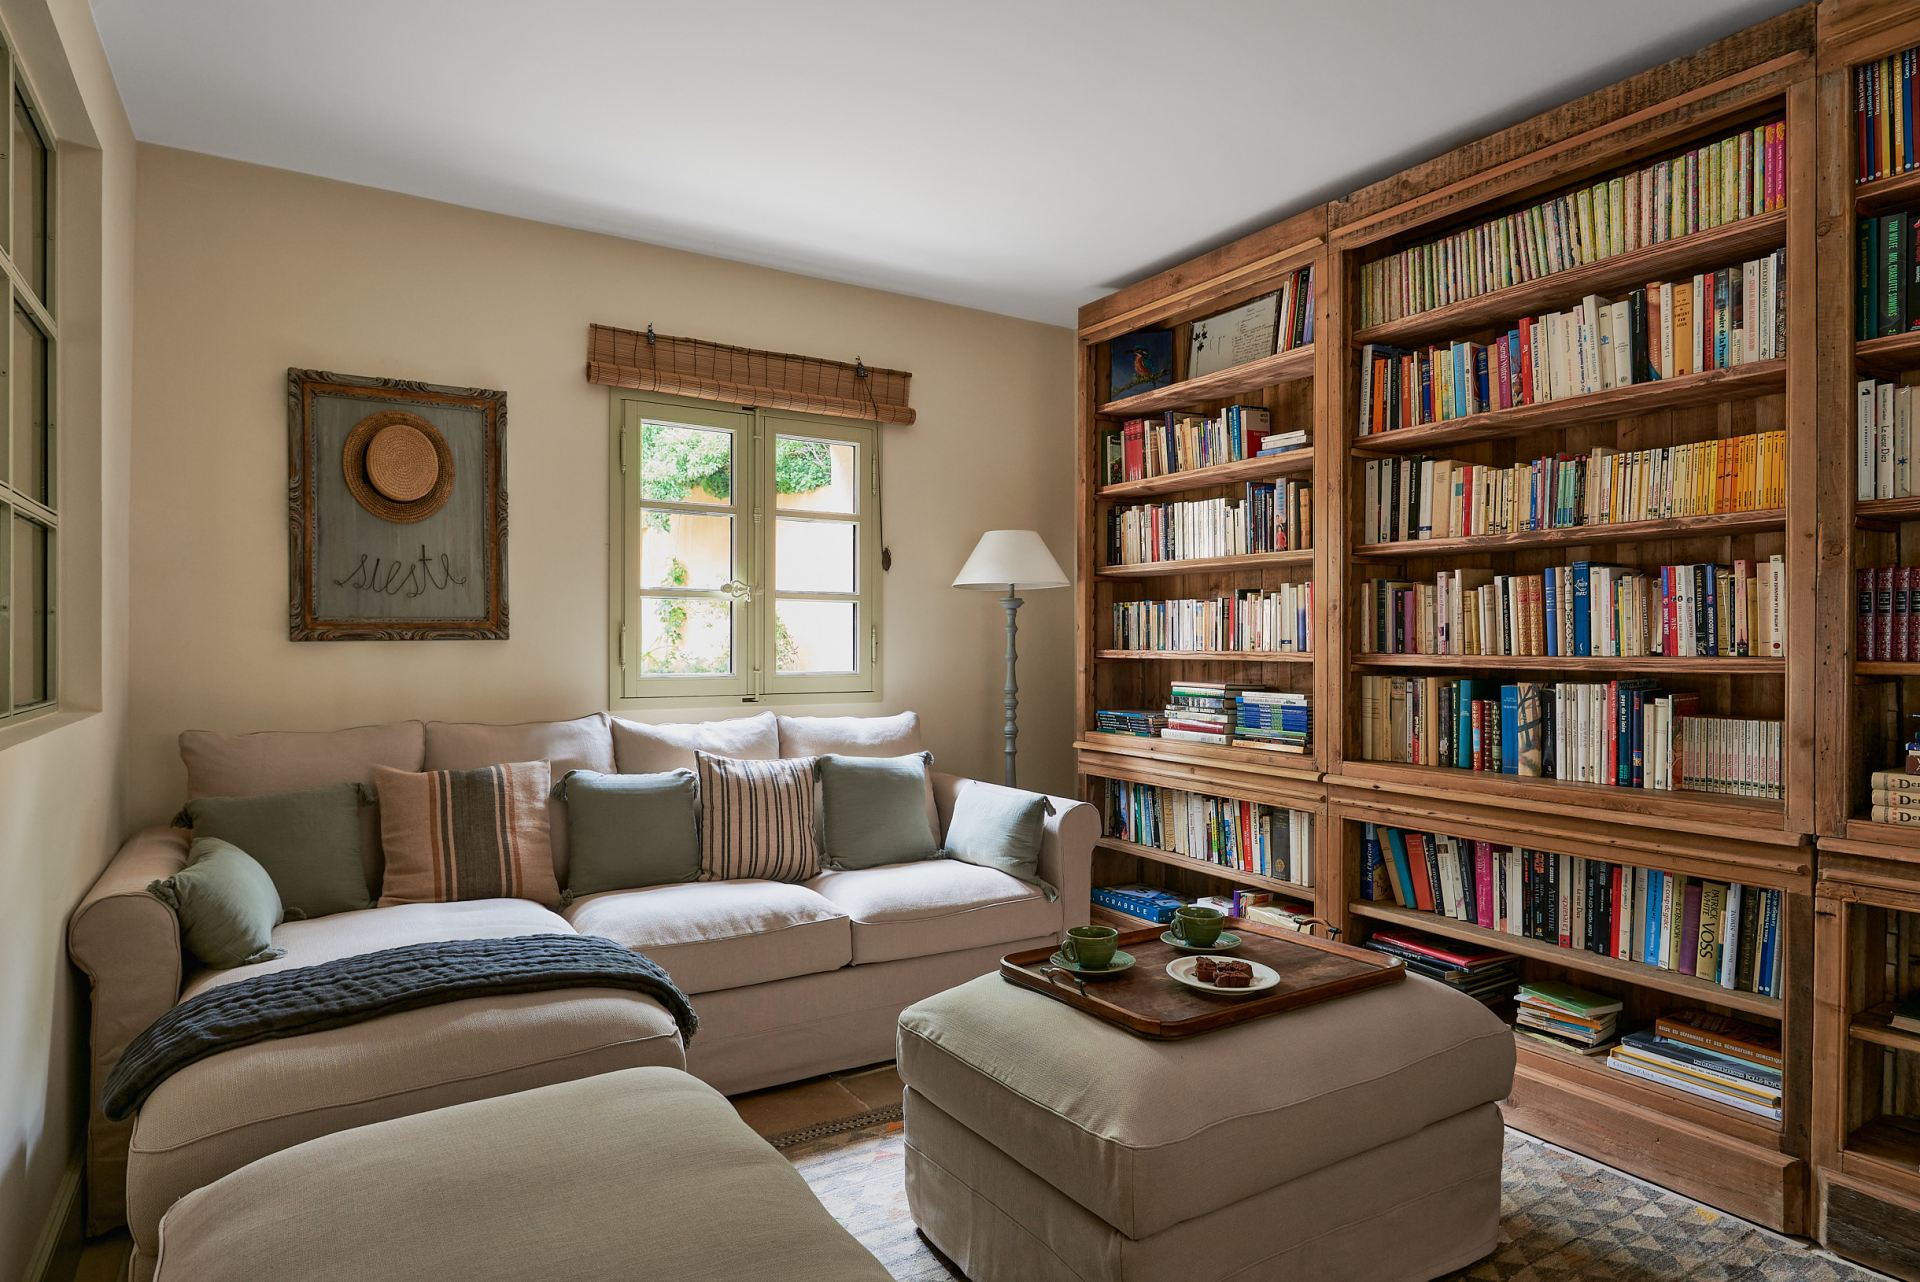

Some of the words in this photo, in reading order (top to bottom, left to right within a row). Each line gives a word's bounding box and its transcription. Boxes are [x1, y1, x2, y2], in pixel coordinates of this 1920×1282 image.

[1889, 220, 1898, 233] TOM
[1889, 233, 1898, 248] WOLFE
[1888, 264, 1898, 292] CHARLOTTE
[1888, 293, 1898, 316] SIMMONS
[1719, 304, 1727, 328] Histoire
[1500, 361, 1508, 383] Waters
[1881, 448, 1889, 463] Dieu
[1100, 895, 1147, 914] SCRABBLE
[1703, 891, 1711, 916] WHITE
[1711, 889, 1719, 920] PATRICK
[1562, 923, 1568, 931] La
[1700, 923, 1715, 958] VOSS
[1756, 1052, 1783, 1065] DOMESTIQU
